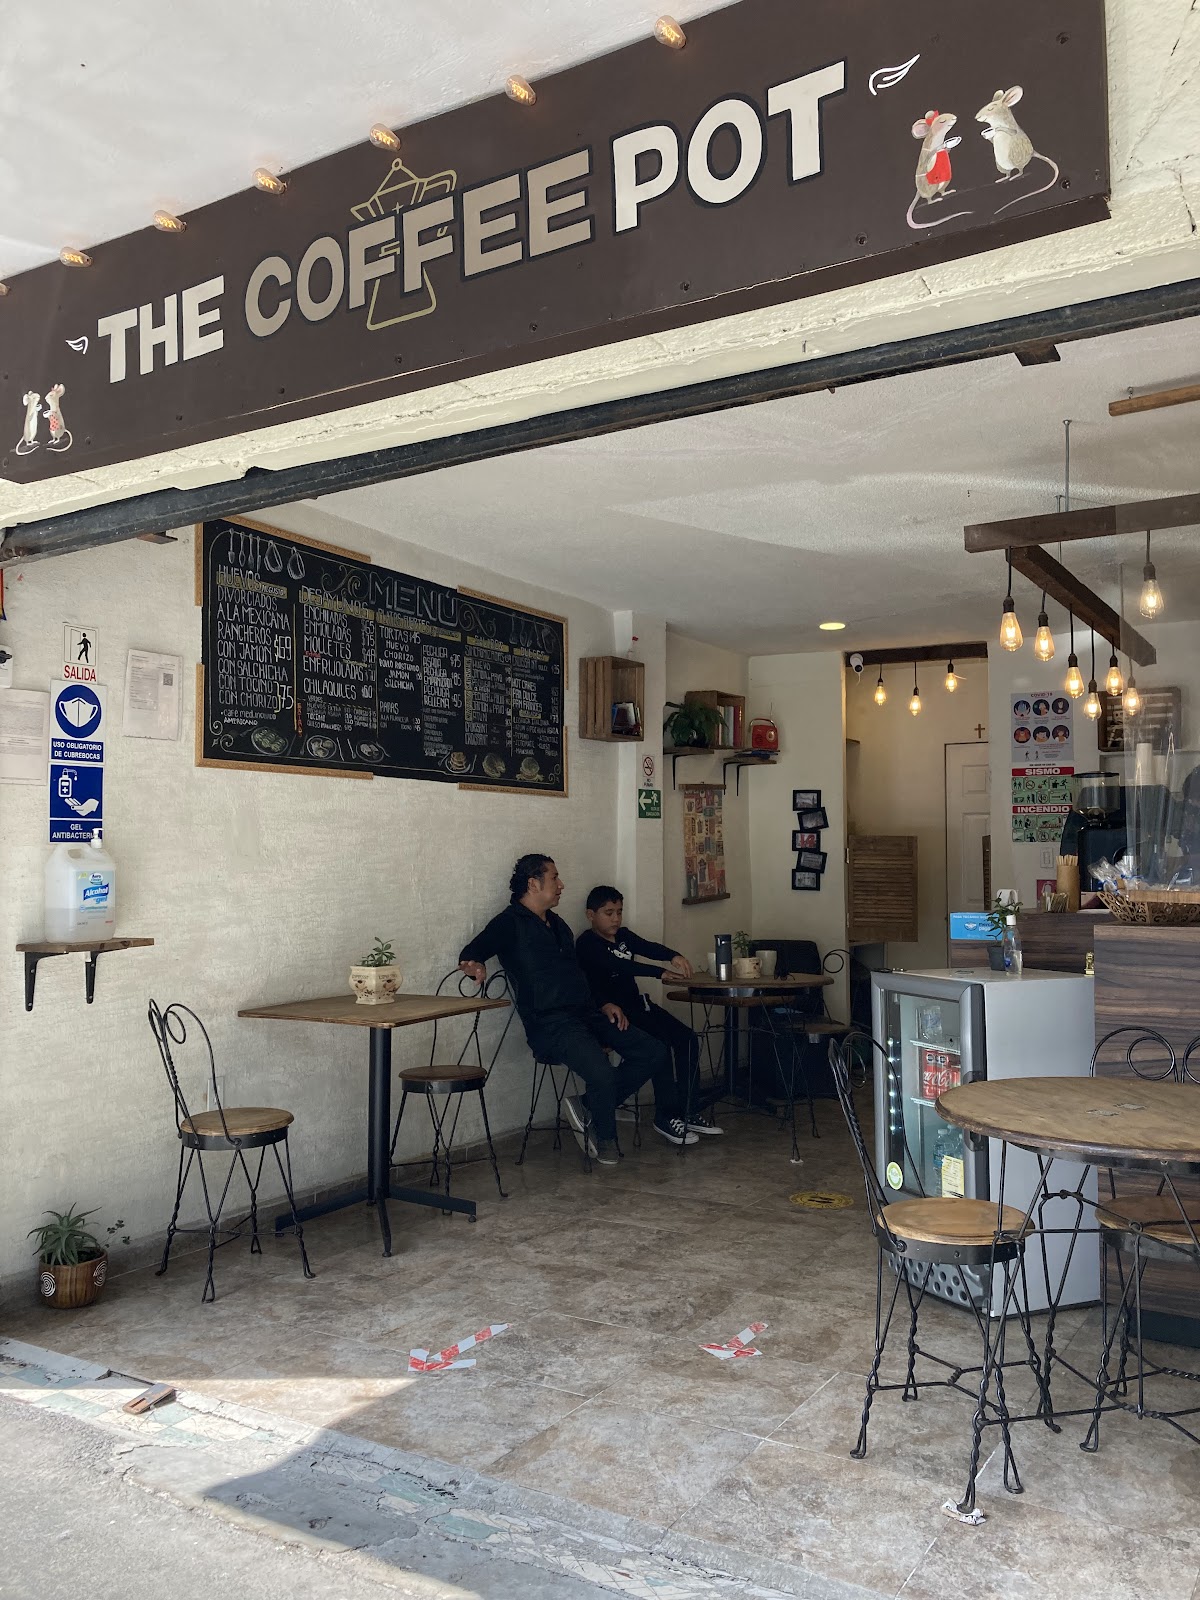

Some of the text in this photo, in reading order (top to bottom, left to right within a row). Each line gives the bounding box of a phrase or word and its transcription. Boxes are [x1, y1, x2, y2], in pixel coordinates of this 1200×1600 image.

[97, 60, 845, 384] THE COFFEE POT
[216, 564, 262, 591] HUEVOS
[217, 585, 278, 612] DIVORCIADOS
[299, 585, 369, 619] DESAYUNOS
[217, 602, 291, 632] A LA MEXICANA
[303, 604, 348, 629] ENCHILADAS
[218, 620, 272, 646] RANCHEROS
[303, 619, 352, 644] ENMOLADAS
[379, 625, 409, 643] TORTAS
[217, 639, 273, 664] CON JAMON
[274, 633, 292, 663] $69
[303, 634, 352, 660] MOLLETES
[383, 649, 414, 662] CHORIZO
[385, 640, 410, 652] HUEVO
[64, 664, 97, 682] SALIDA
[217, 657, 289, 682] CON SALCHICHA
[303, 655, 364, 682] ENFRIJOLADAS
[218, 673, 274, 694] CON TOCINO
[303, 677, 357, 700] CHILAQUILES
[218, 689, 279, 709] CON CHORIZO
[54, 750, 101, 760] DE CUBREBOCAS
[67, 742, 102, 751] OBLIGATORIO
[1025, 767, 1061, 776] SISMO
[1017, 805, 1070, 813] INCENDIO
[70, 823, 83, 831] GEL
[84, 887, 109, 897] Alcohol
